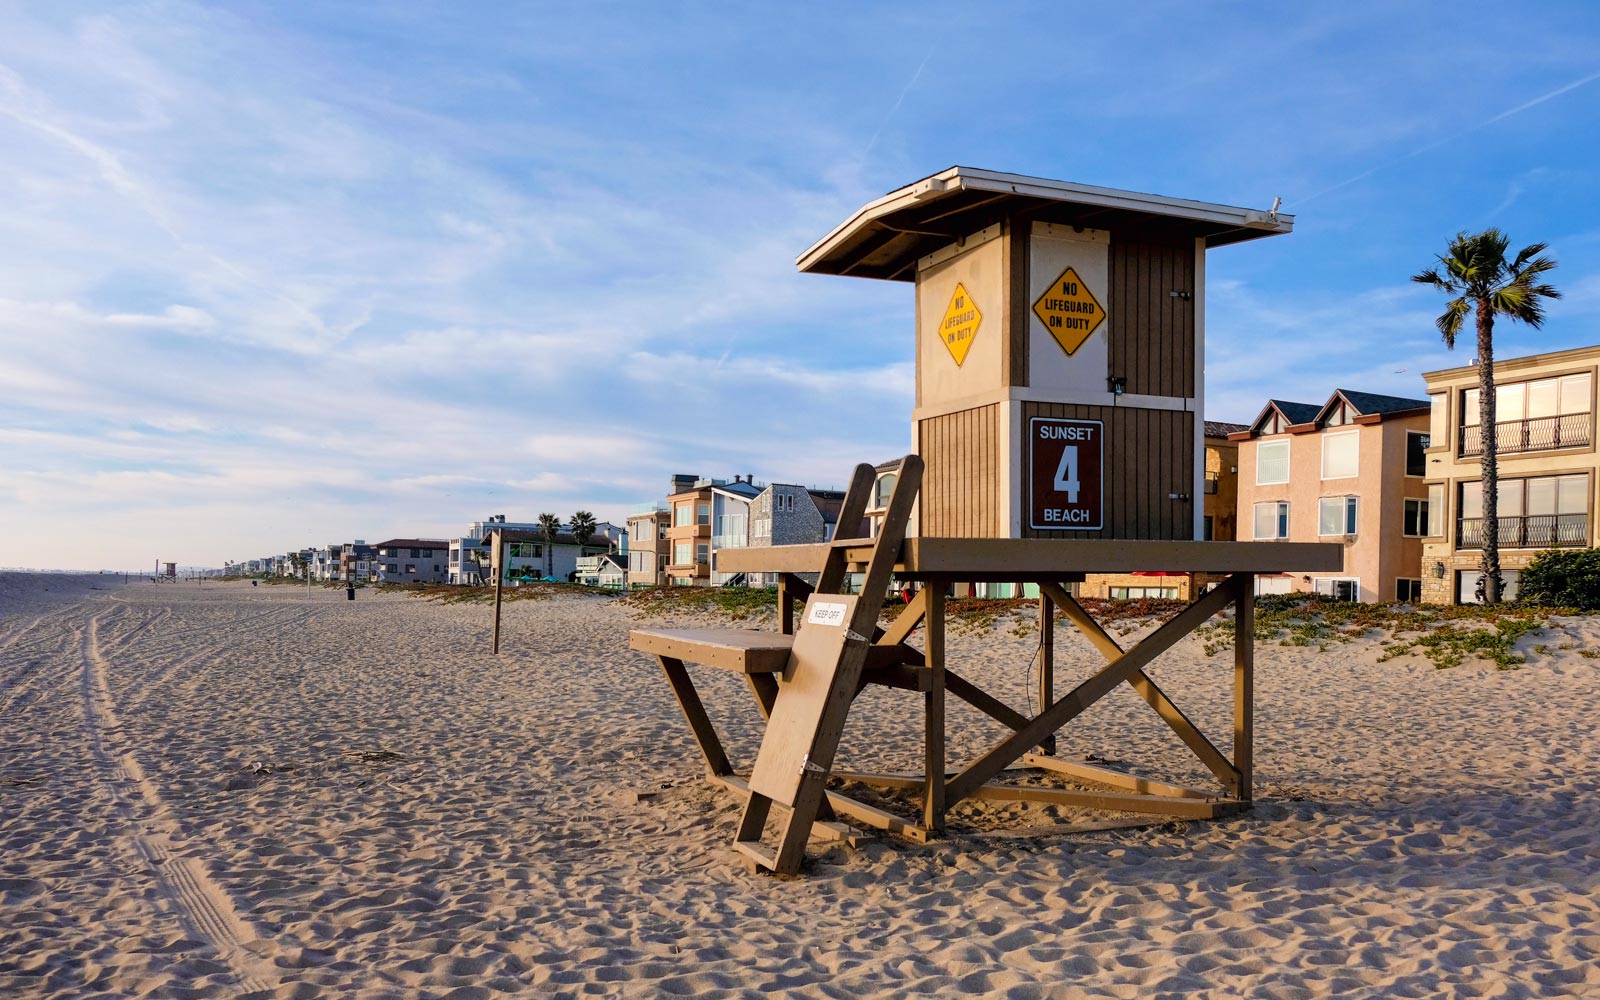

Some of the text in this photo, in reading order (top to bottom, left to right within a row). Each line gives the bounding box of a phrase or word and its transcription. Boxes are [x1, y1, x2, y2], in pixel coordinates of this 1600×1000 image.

[1063, 281, 1077, 296] NO
[955, 295, 965, 310] NO
[1045, 298, 1094, 314] LIFEGUARD
[945, 310, 975, 329] LIFEGUARD
[1049, 315, 1090, 330] ON DUTY
[947, 326, 972, 344] ON DUTY
[1040, 426, 1093, 440] SUNSET
[1053, 445, 1080, 504] 4
[1043, 508, 1090, 522] BEACH
[815, 609, 840, 619] KEEP OFF
